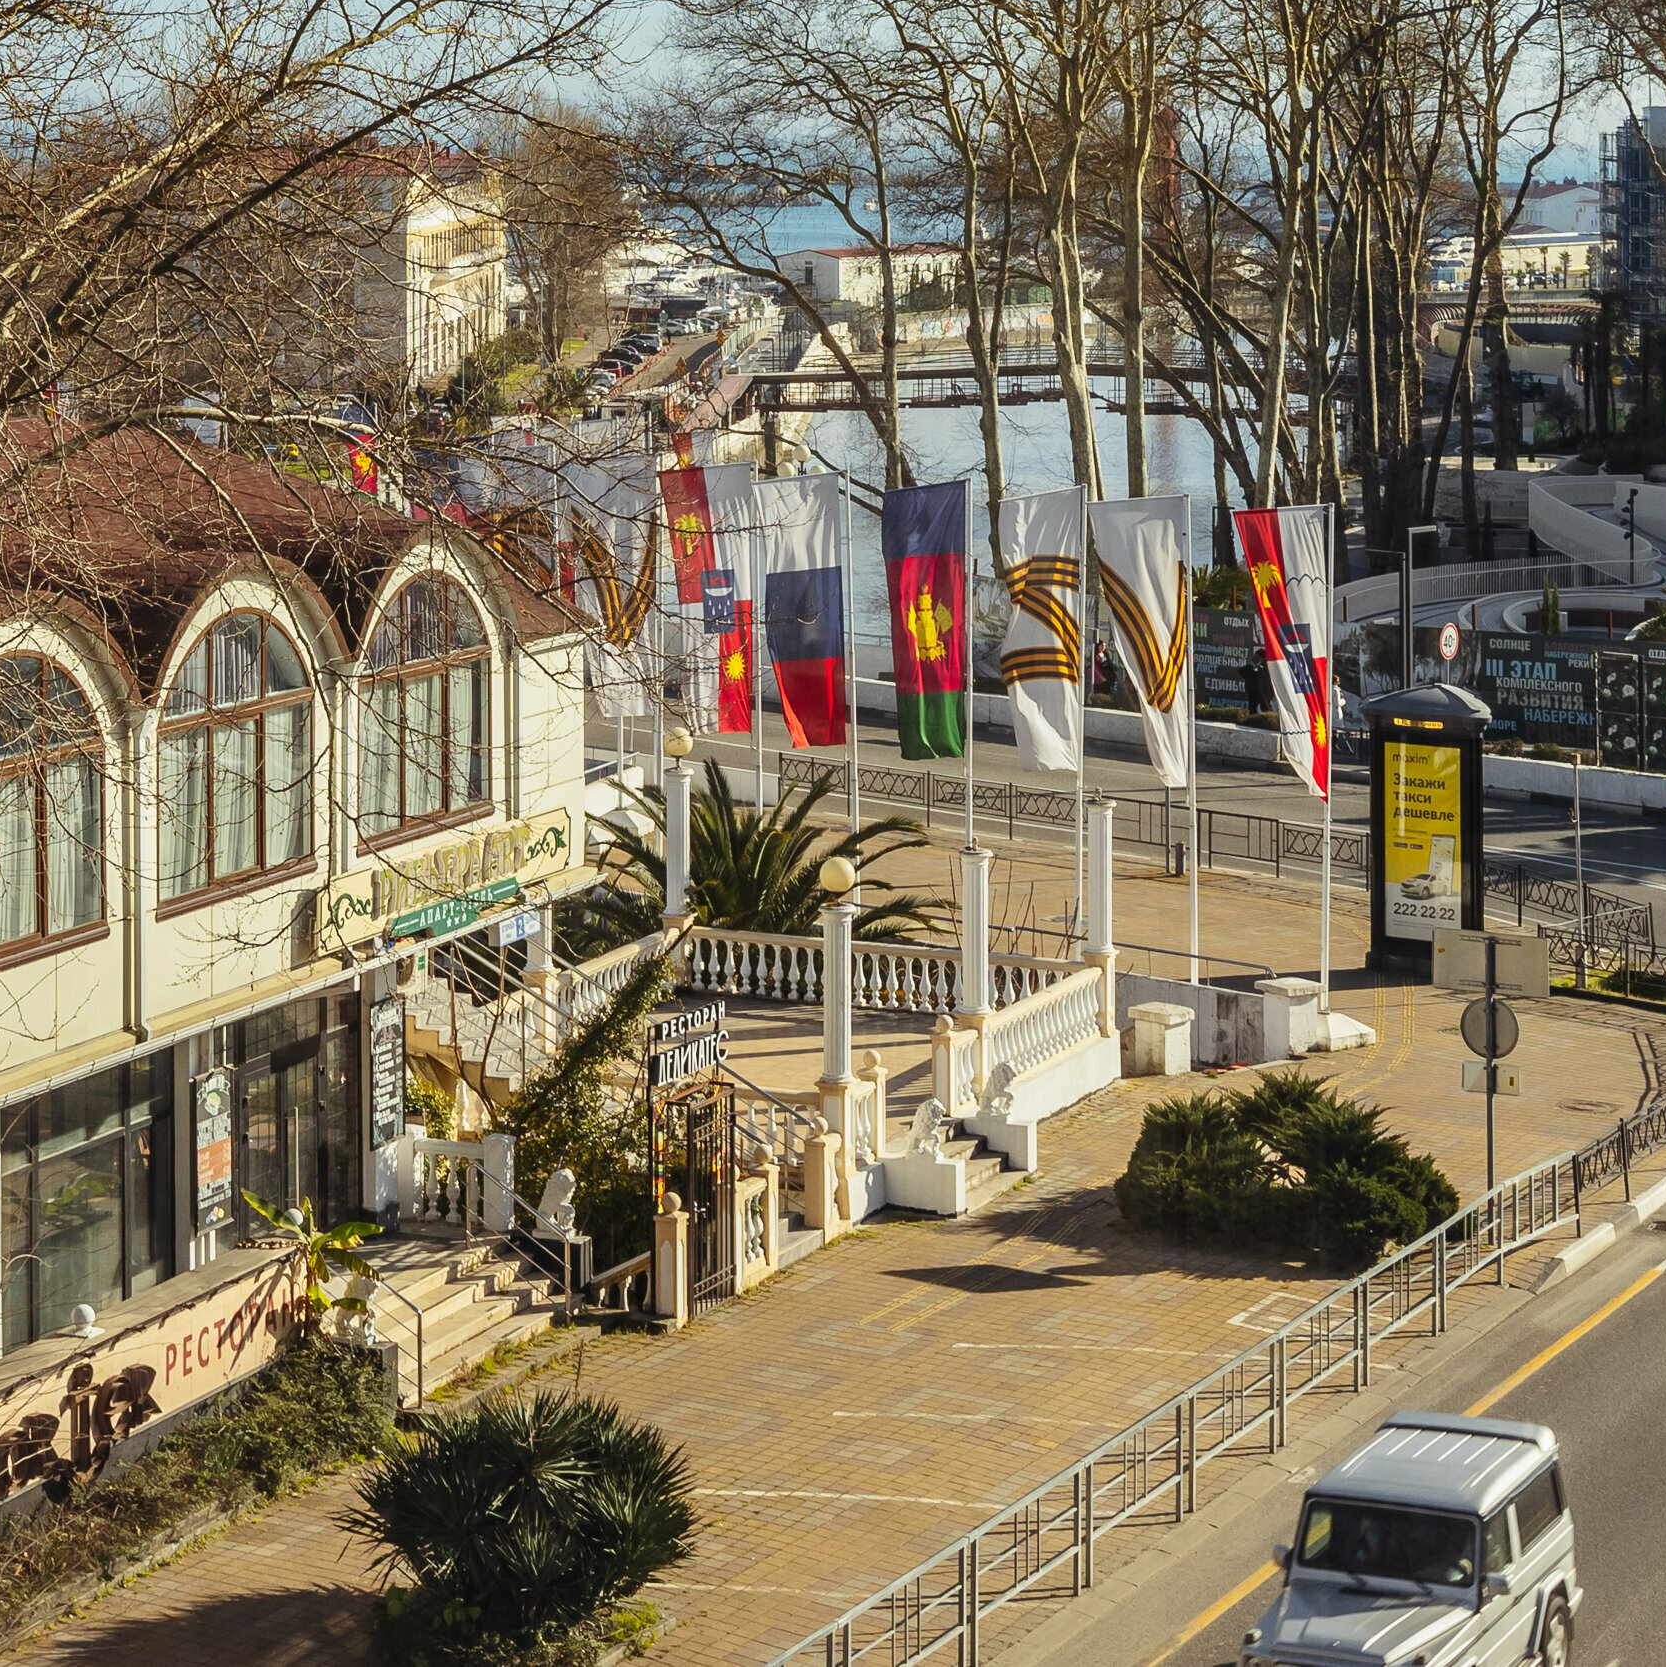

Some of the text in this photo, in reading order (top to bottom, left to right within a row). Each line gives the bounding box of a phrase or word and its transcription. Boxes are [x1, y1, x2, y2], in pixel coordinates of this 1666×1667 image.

[1193, 622, 1208, 638] ЧИ
[1223, 616, 1250, 628] ОТДЫХ
[1489, 638, 1532, 652] СОЛНЦЕ
[1544, 650, 1589, 660] НАБЕРЕЖНОЙ
[1196, 663, 1218, 675] ЛИСТ
[1510, 659, 1557, 681] ЭТАП
[1568, 658, 1590, 669] РЕКИ
[1496, 676, 1582, 694] КОМПЛЕКСНОГО
[1497, 688, 1584, 711] РАЗВИТИЯ
[1489, 719, 1517, 731] МОРЕ
[1393, 772, 1446, 790] Закажи
[1393, 791, 1432, 804] такси
[662, 1000, 725, 1041] РЕСТОРАН
[658, 1029, 729, 1087] ДЕЛИКАТЕС
[165, 1287, 295, 1386] РЕСТОРАН
